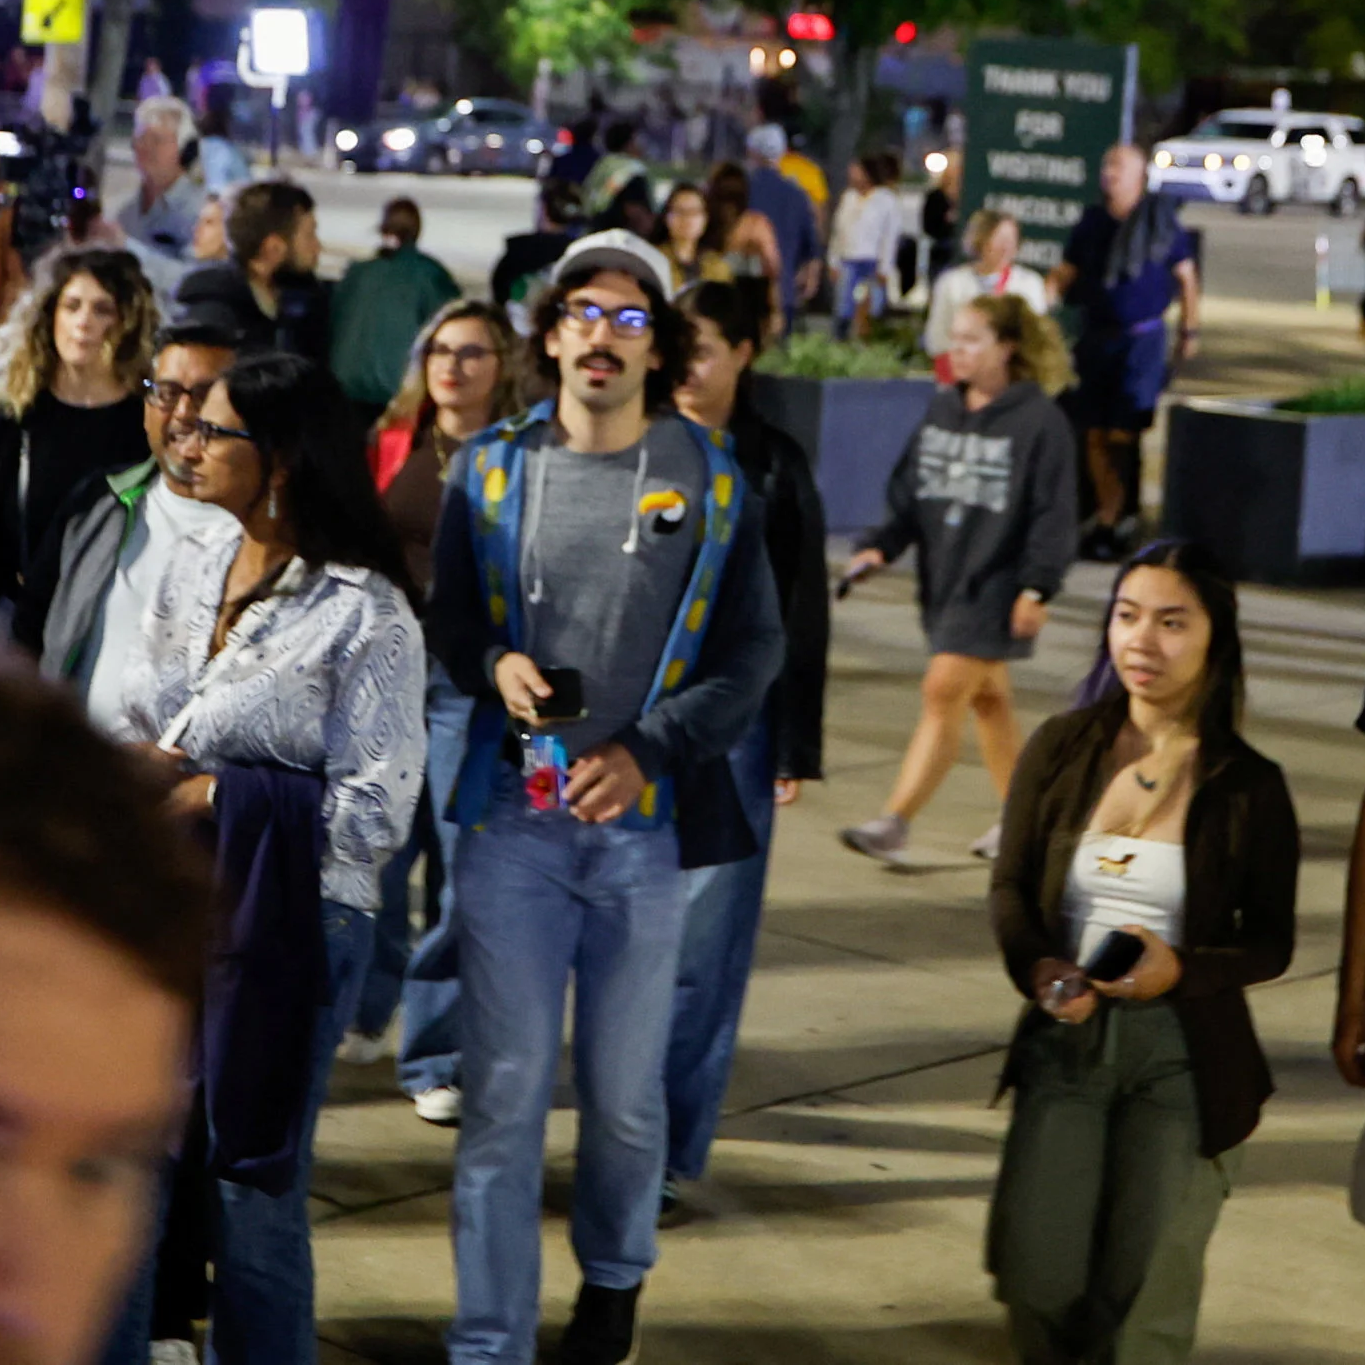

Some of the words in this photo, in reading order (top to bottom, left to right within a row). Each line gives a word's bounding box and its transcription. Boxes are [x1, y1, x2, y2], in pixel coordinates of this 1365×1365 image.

[983, 64, 1060, 97] THANK
[1064, 71, 1113, 103] YOU
[1014, 109, 1065, 141] FOR
[988, 151, 1086, 185] VISITING
